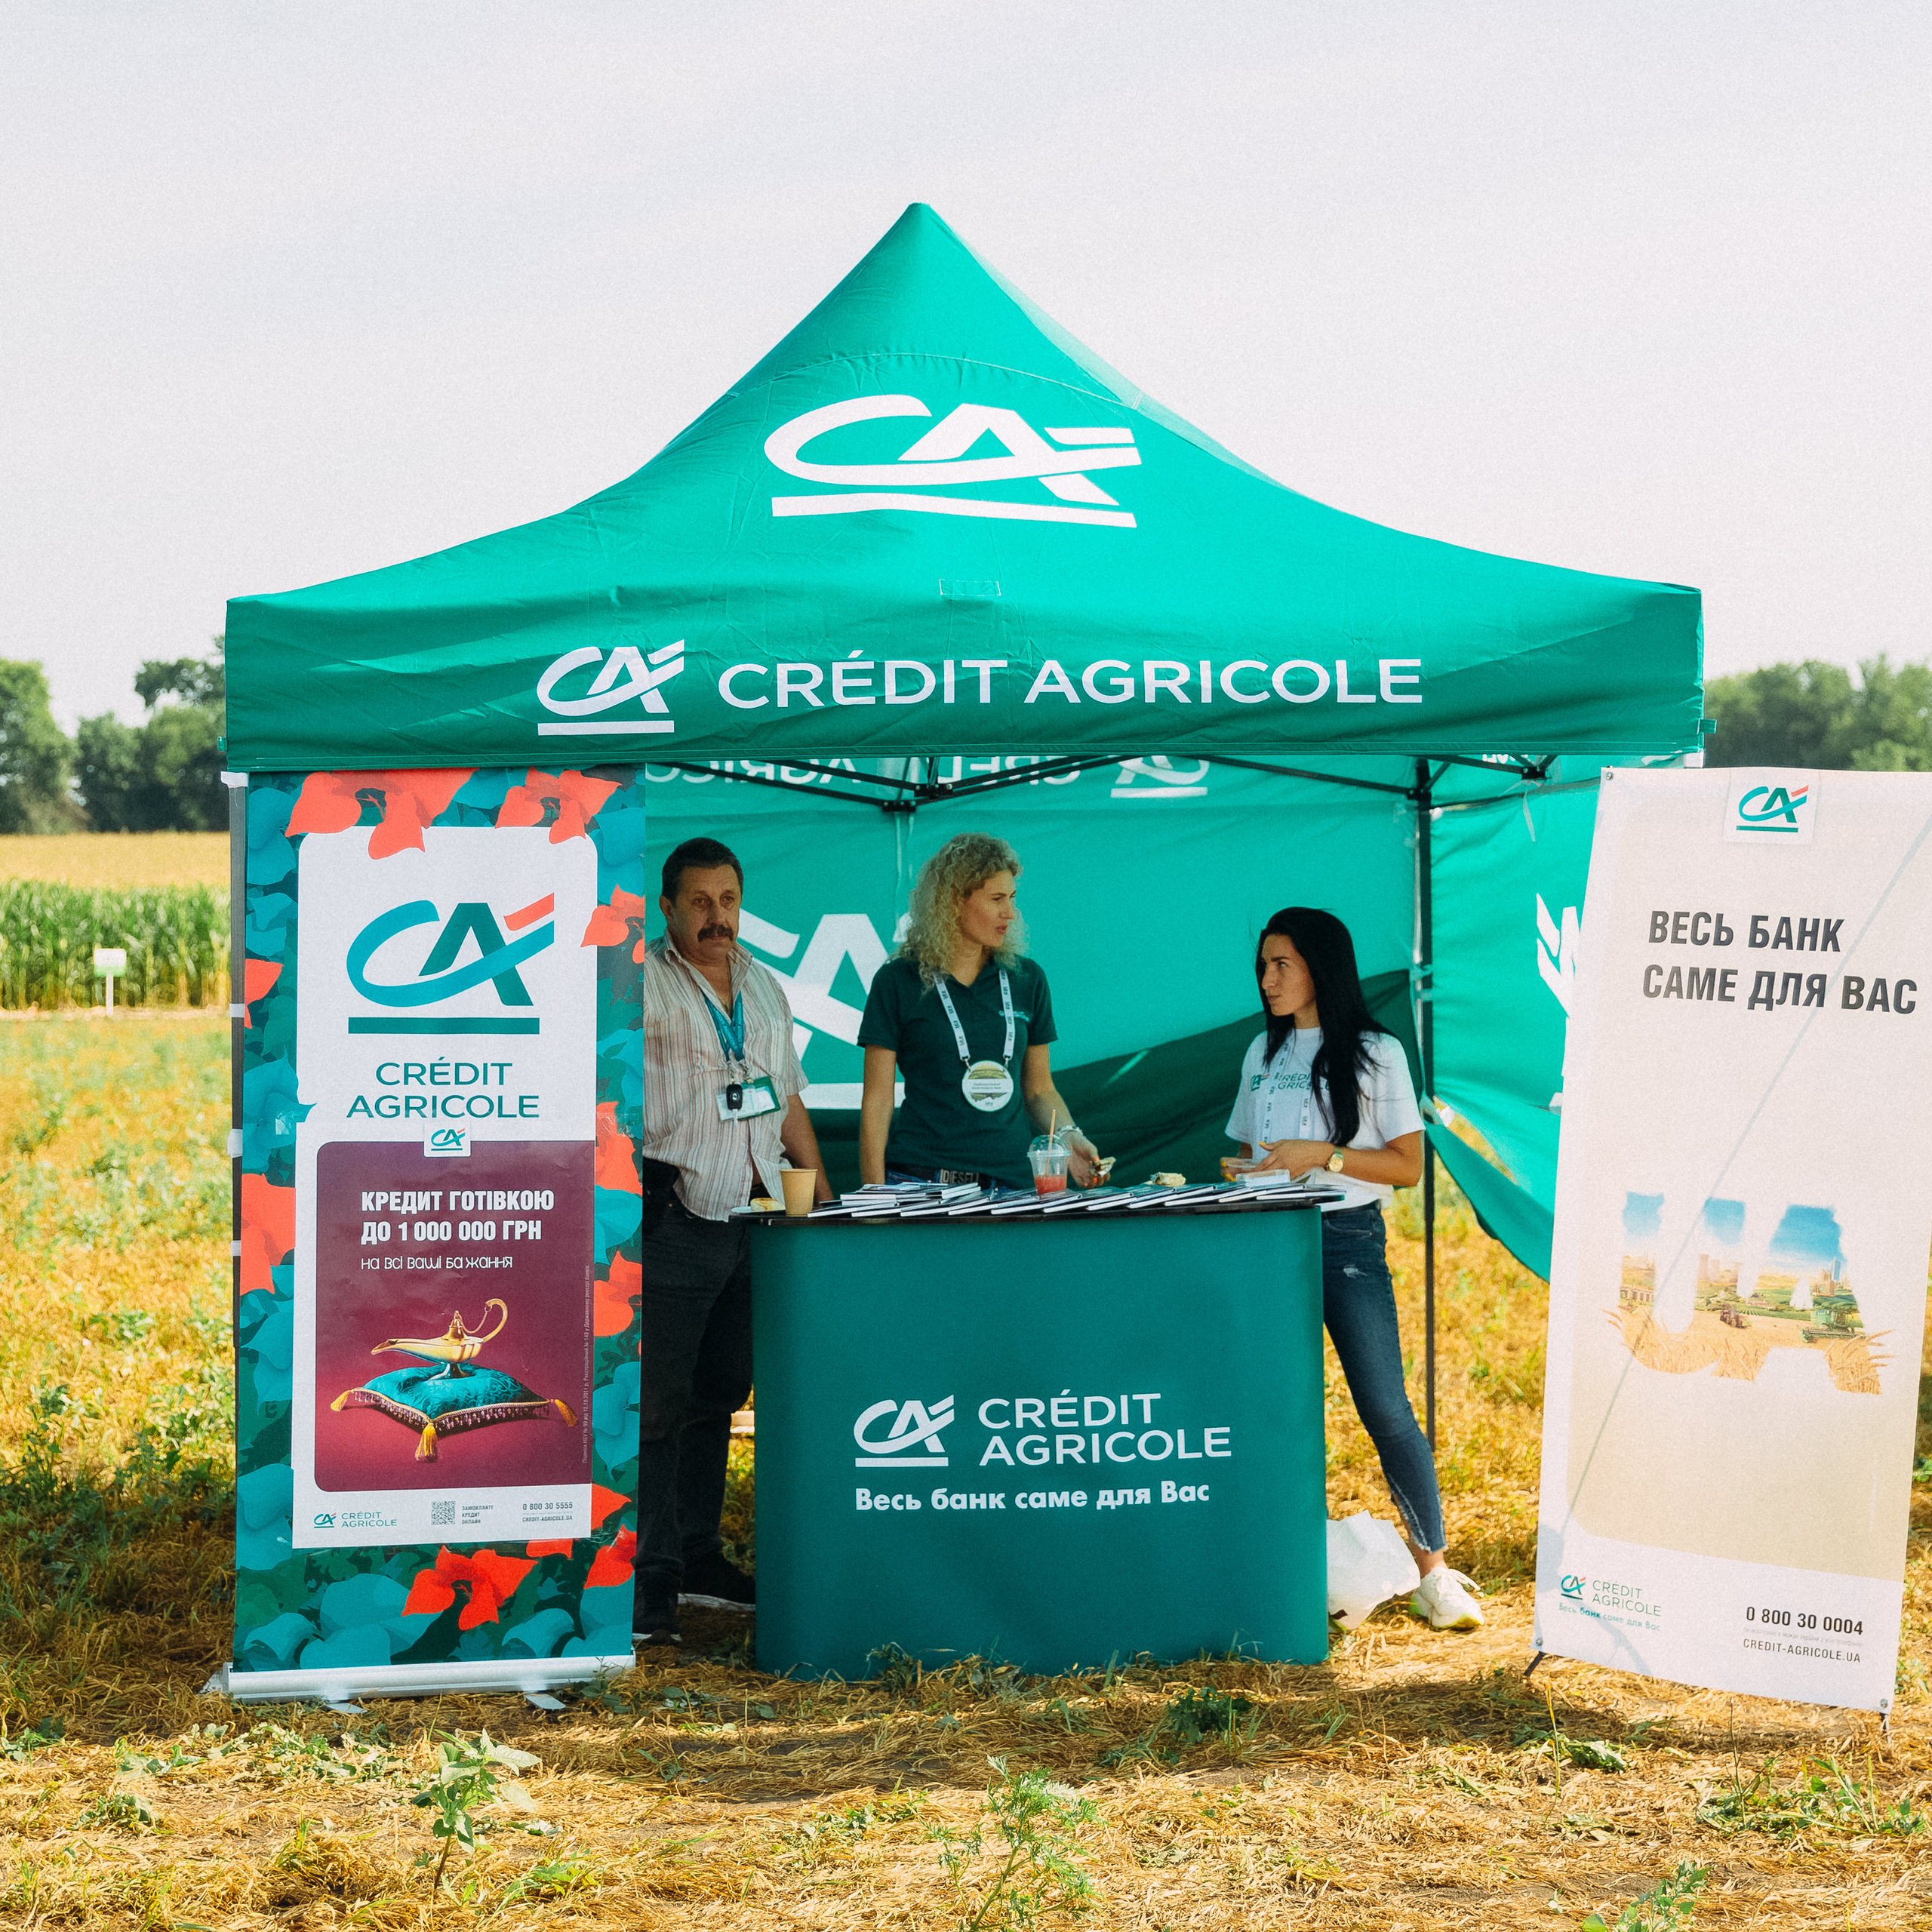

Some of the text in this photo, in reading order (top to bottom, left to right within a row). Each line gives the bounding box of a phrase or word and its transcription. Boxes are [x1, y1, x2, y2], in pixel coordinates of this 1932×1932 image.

[718, 650, 1423, 709] CRÉDIT AGRICOLE
[1648, 910, 1845, 952] ВЕСЬ БАНК
[1642, 964, 1918, 1014] САМЕ ДЛЯ ВАС
[376, 1057, 513, 1086] CRÉDIT
[346, 1094, 540, 1118] AGRICOLE
[361, 1189, 555, 1215] КРЕДИТ ГОТІВКОЮ
[361, 1220, 542, 1245] ДО 1 000 000 ГРН
[361, 1257, 380, 1270] на
[384, 1256, 403, 1269] всі
[407, 1256, 441, 1269] ваші
[978, 1389, 1161, 1429] CRÉDIT
[979, 1426, 1232, 1466] AGRICOLE
[544, 1502, 554, 1510] 30
[555, 1501, 574, 1509] 5555
[855, 1480, 1210, 1510] Весь банк саме для Вас
[341, 1511, 383, 1520] CRÉDIT
[341, 1518, 397, 1528] AGRICOLE
[1580, 1607, 1601, 1619] банк
[1592, 1593, 1662, 1617] AGRICOLE
[1746, 1606, 1863, 1635] 0 800 30 0004
[1743, 1638, 1861, 1663] CREDIT-AGRICOLE.UA
